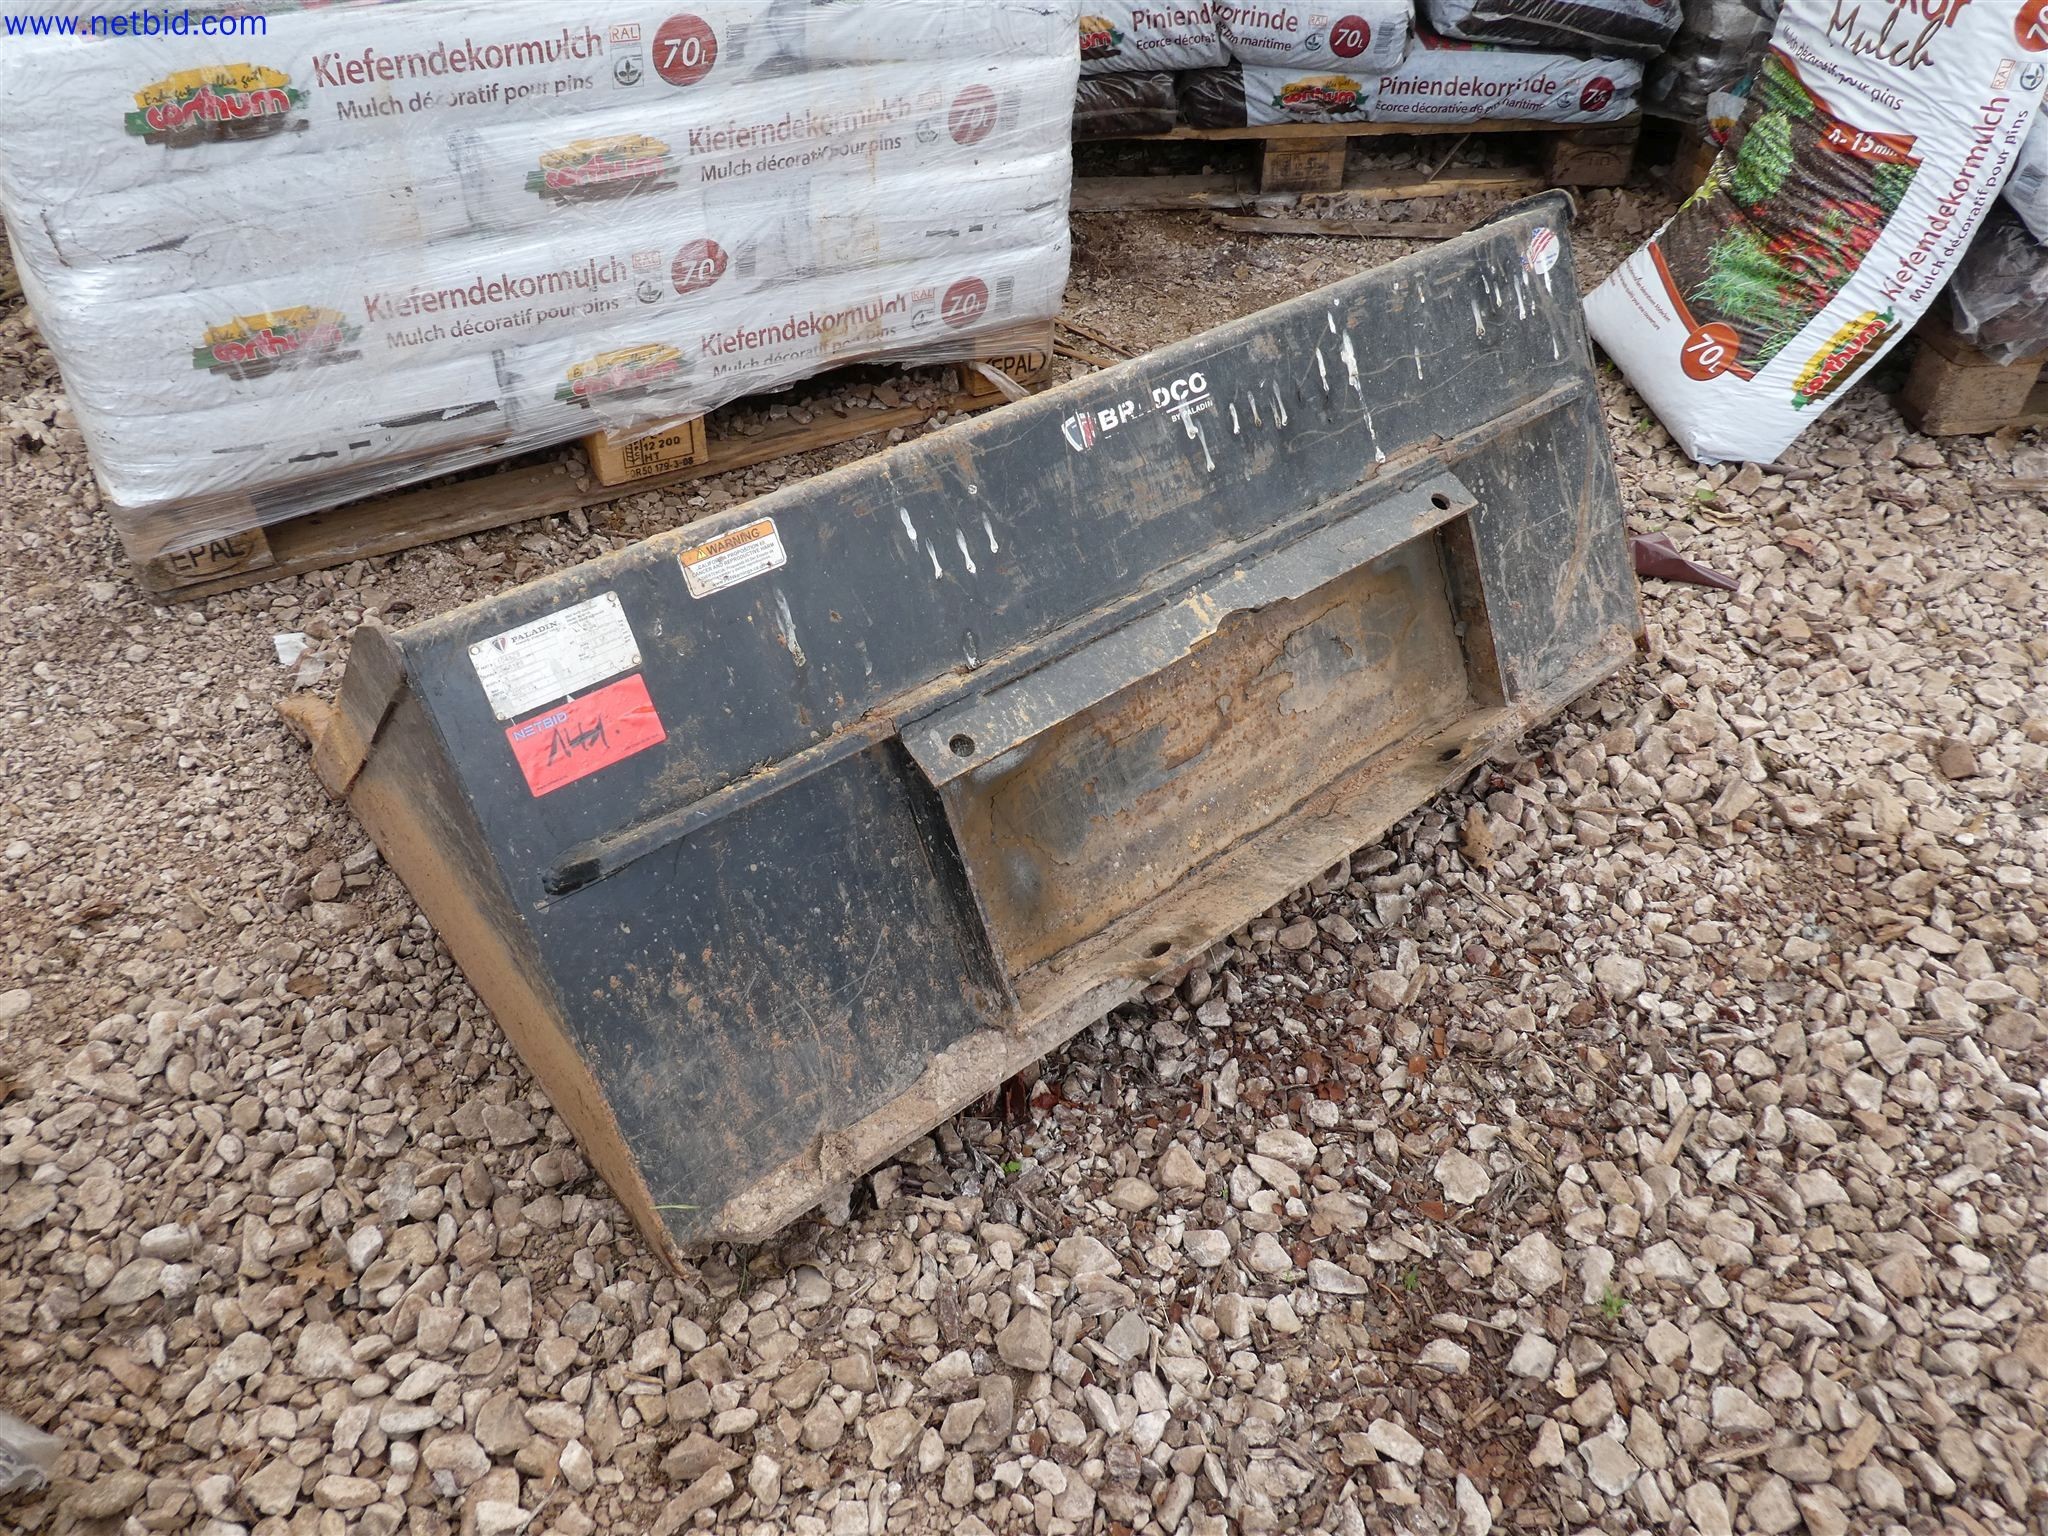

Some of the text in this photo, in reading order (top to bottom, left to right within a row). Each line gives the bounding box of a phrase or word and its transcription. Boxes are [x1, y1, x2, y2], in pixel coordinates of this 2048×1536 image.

[611, 25, 639, 40] RAL
[1131, 2, 1298, 32] Piniendkorrinde
[1240, 36, 1291, 51] maritime
[1826, 0, 1945, 70] Mulch
[311, 26, 604, 88] Kieferndekormulch
[1993, 61, 2014, 88] RAL
[336, 95, 404, 121] Mulch
[408, 82, 499, 113] déoratif
[554, 74, 594, 97] pins
[1411, 101, 1468, 114] décorative
[1469, 103, 1484, 114] de
[1871, 88, 1904, 111] pins
[700, 159, 752, 183] Mulch
[866, 131, 902, 158] pins
[1879, 96, 2010, 302] Kieferndekormulch
[1909, 110, 2029, 302] Mulch décoratif pour pins
[363, 254, 628, 323] Kieferndekormulch
[386, 324, 446, 350] Mulch
[449, 308, 533, 339] décoratif
[1097, 371, 1208, 433] BRDCO
[644, 452, 660, 463] HT
[658, 435, 681, 449] 200
[170, 538, 246, 572] EPAL
[706, 528, 760, 556] WARNING
[511, 620, 558, 643] PALADIN
[512, 710, 569, 742] NETBID
